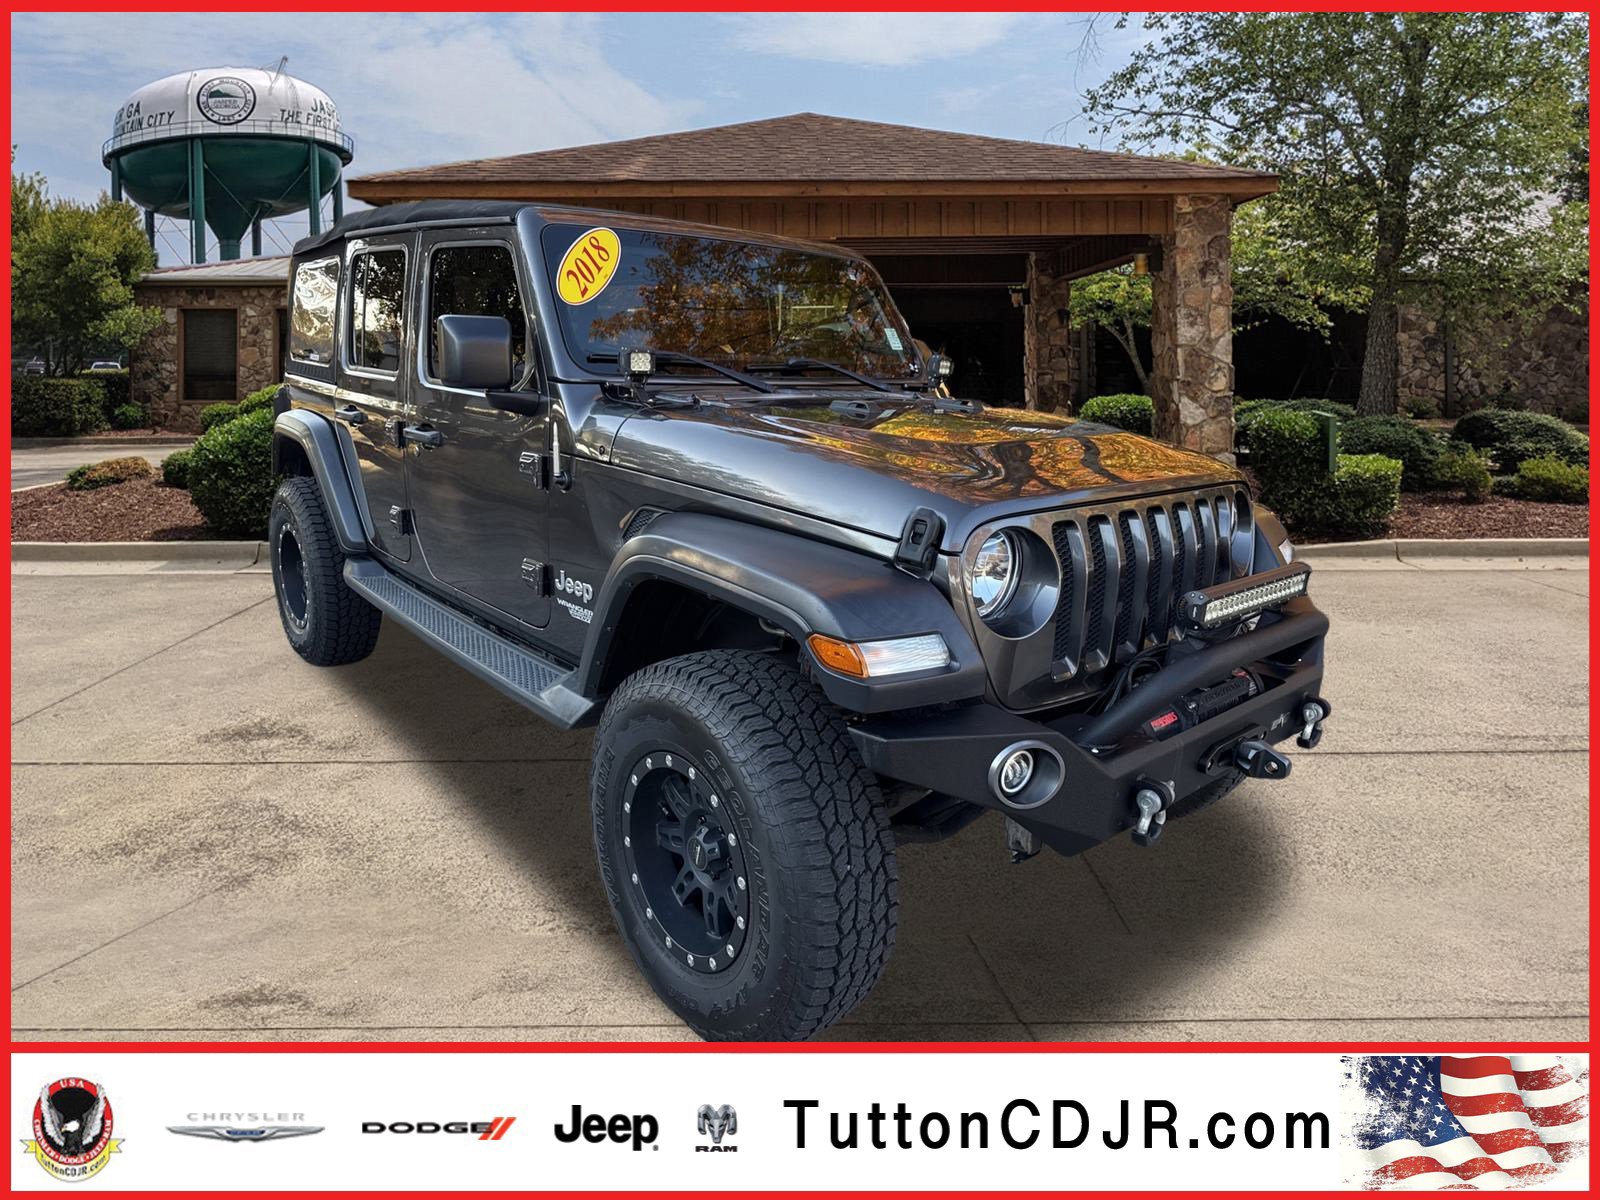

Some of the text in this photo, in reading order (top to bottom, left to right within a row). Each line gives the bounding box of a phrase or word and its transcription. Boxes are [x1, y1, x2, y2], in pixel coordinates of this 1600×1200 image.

[126, 100, 141, 119] GA
[147, 110, 175, 128] CITY
[280, 108, 302, 124] THE
[306, 112, 331, 130] FIRST
[566, 235, 610, 298] 2018
[554, 569, 593, 604] Jeep
